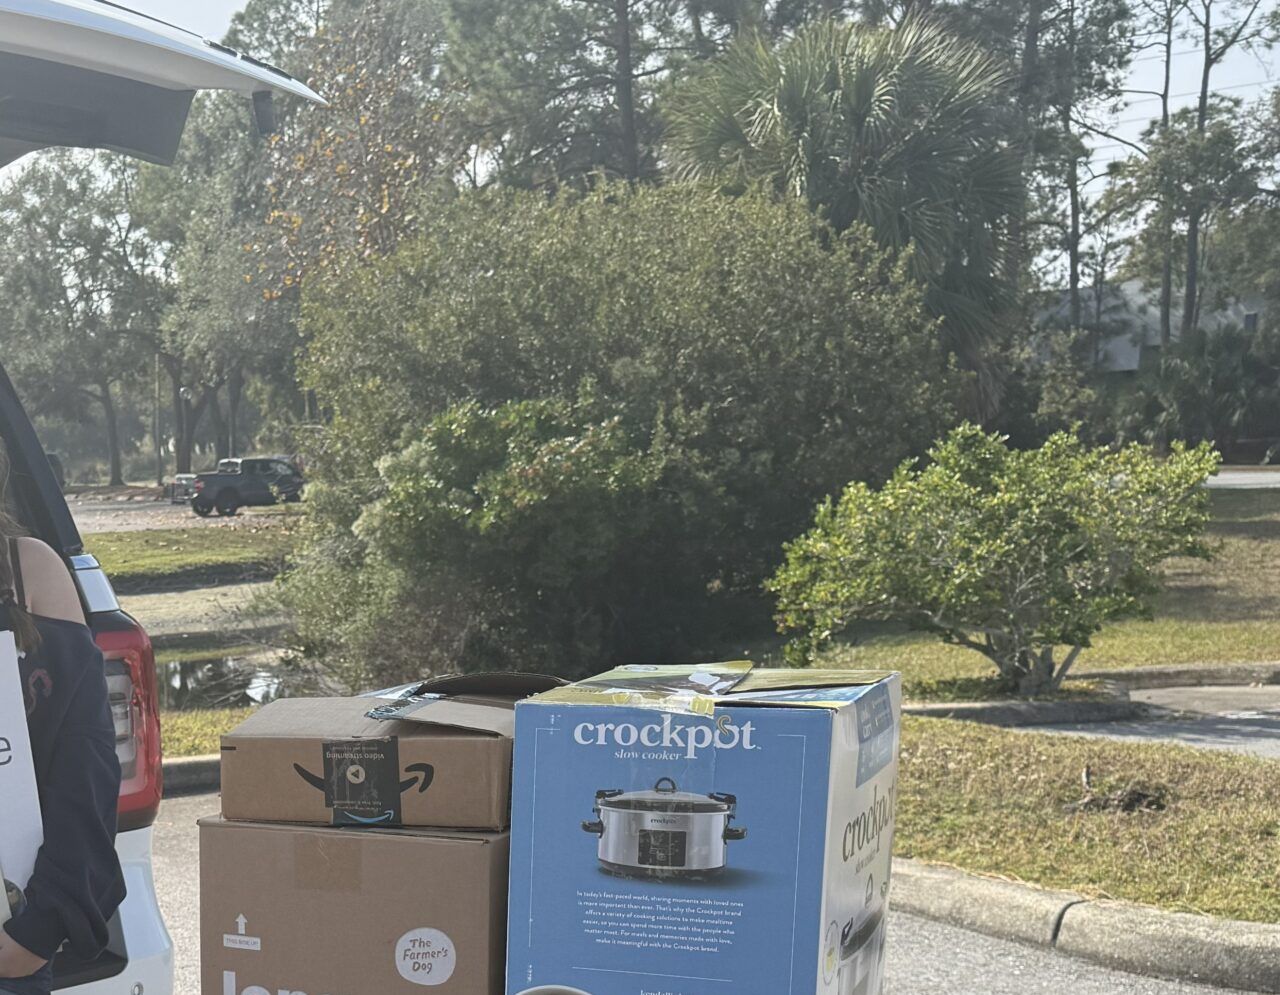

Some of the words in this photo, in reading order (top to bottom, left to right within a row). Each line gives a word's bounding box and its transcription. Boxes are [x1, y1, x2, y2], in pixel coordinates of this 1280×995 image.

[573, 714, 756, 760] crockpot
[364, 752, 385, 760] video
[614, 748, 639, 760] slow
[641, 750, 684, 761] cooker
[409, 937, 432, 949] The
[403, 947, 449, 961] Farmer's
[412, 961, 433, 974] Dog
